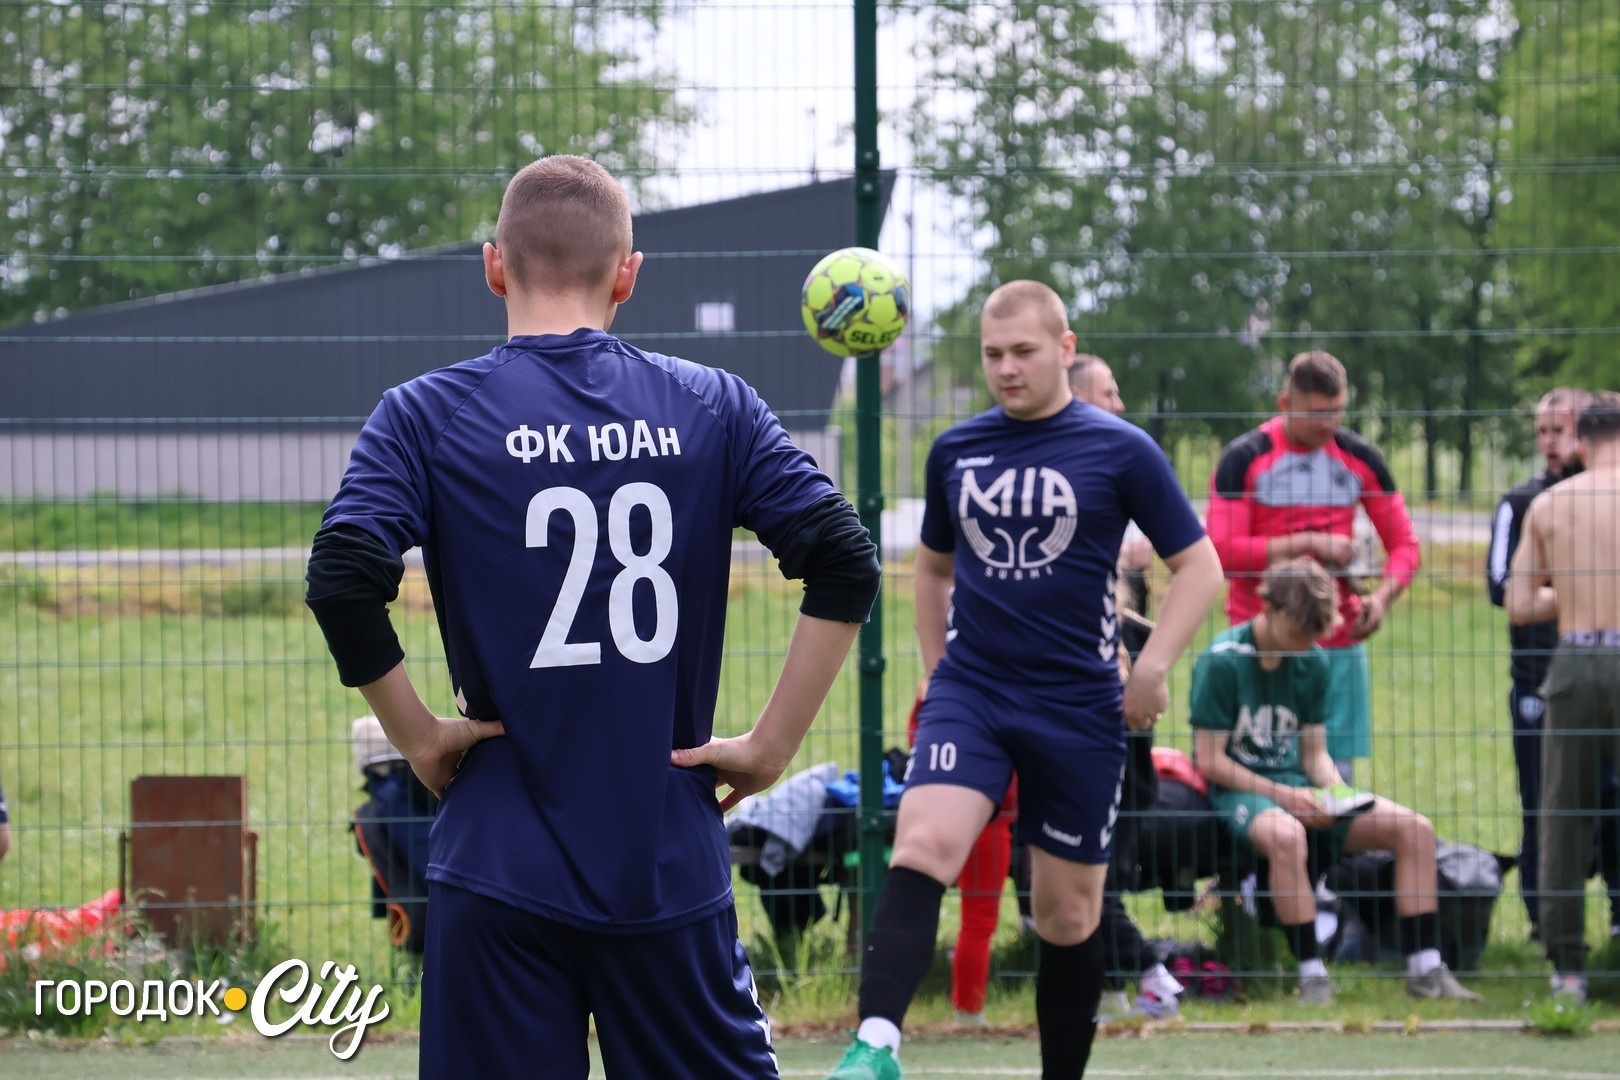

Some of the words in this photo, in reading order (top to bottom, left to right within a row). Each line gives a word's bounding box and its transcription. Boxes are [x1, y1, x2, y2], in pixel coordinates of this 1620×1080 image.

[505, 424, 575, 463] ФК
[958, 466, 1078, 519] MIA
[525, 481, 679, 669] 28
[929, 741, 957, 772] 10
